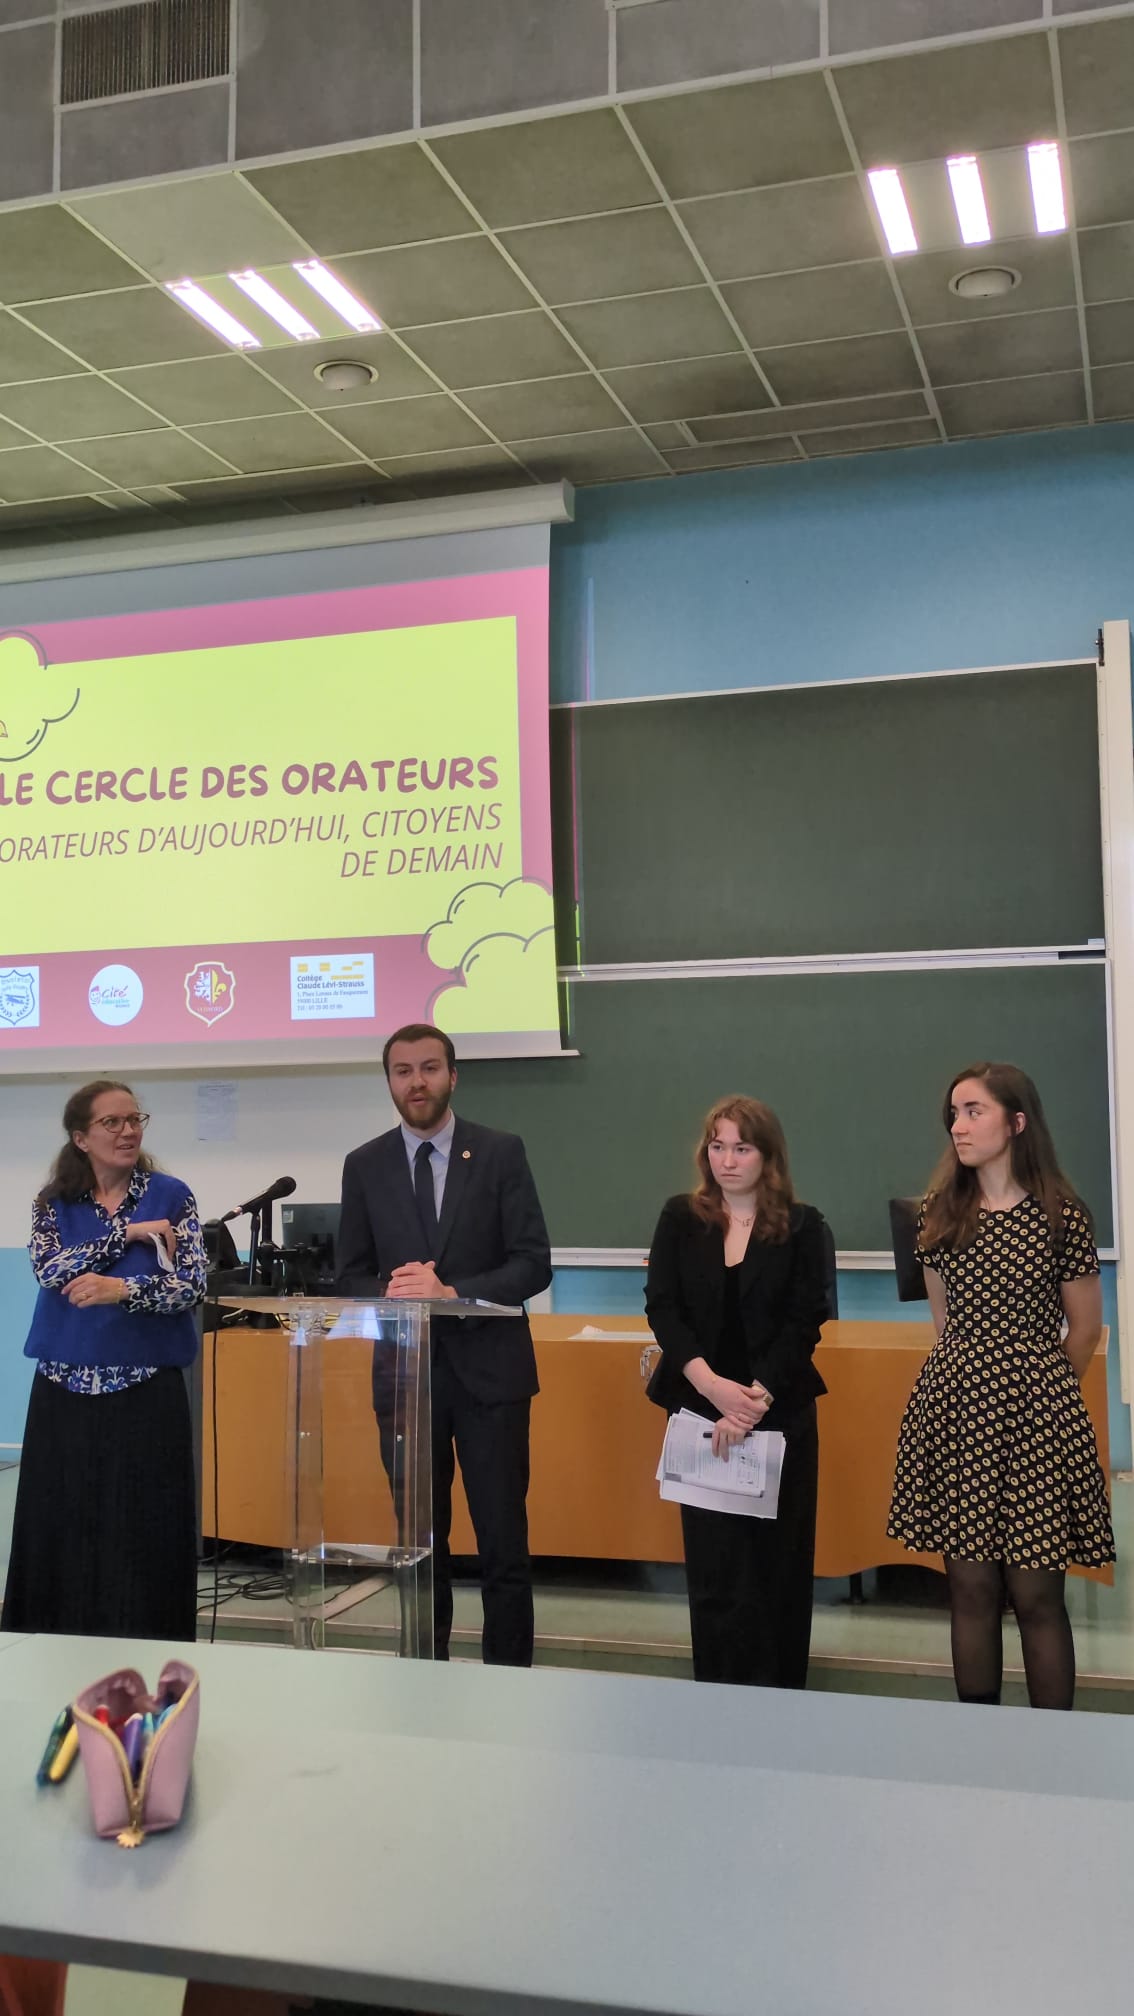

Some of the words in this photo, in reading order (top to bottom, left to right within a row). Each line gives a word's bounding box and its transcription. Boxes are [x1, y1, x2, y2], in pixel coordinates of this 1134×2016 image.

[0, 772, 33, 806] LE
[46, 766, 188, 805] CERCLE
[200, 764, 268, 799] DES
[282, 755, 499, 795] ORATEURS
[0, 829, 130, 863] ORATEURS
[138, 813, 350, 856] D'AUJOURD'HUI,
[362, 802, 503, 838] CITOYENS
[340, 850, 379, 878] DE
[387, 842, 503, 875] DEMAIN
[297, 975, 323, 983] Collège
[297, 982, 321, 990] Claude
[322, 981, 365, 989] Lévi-Strauss
